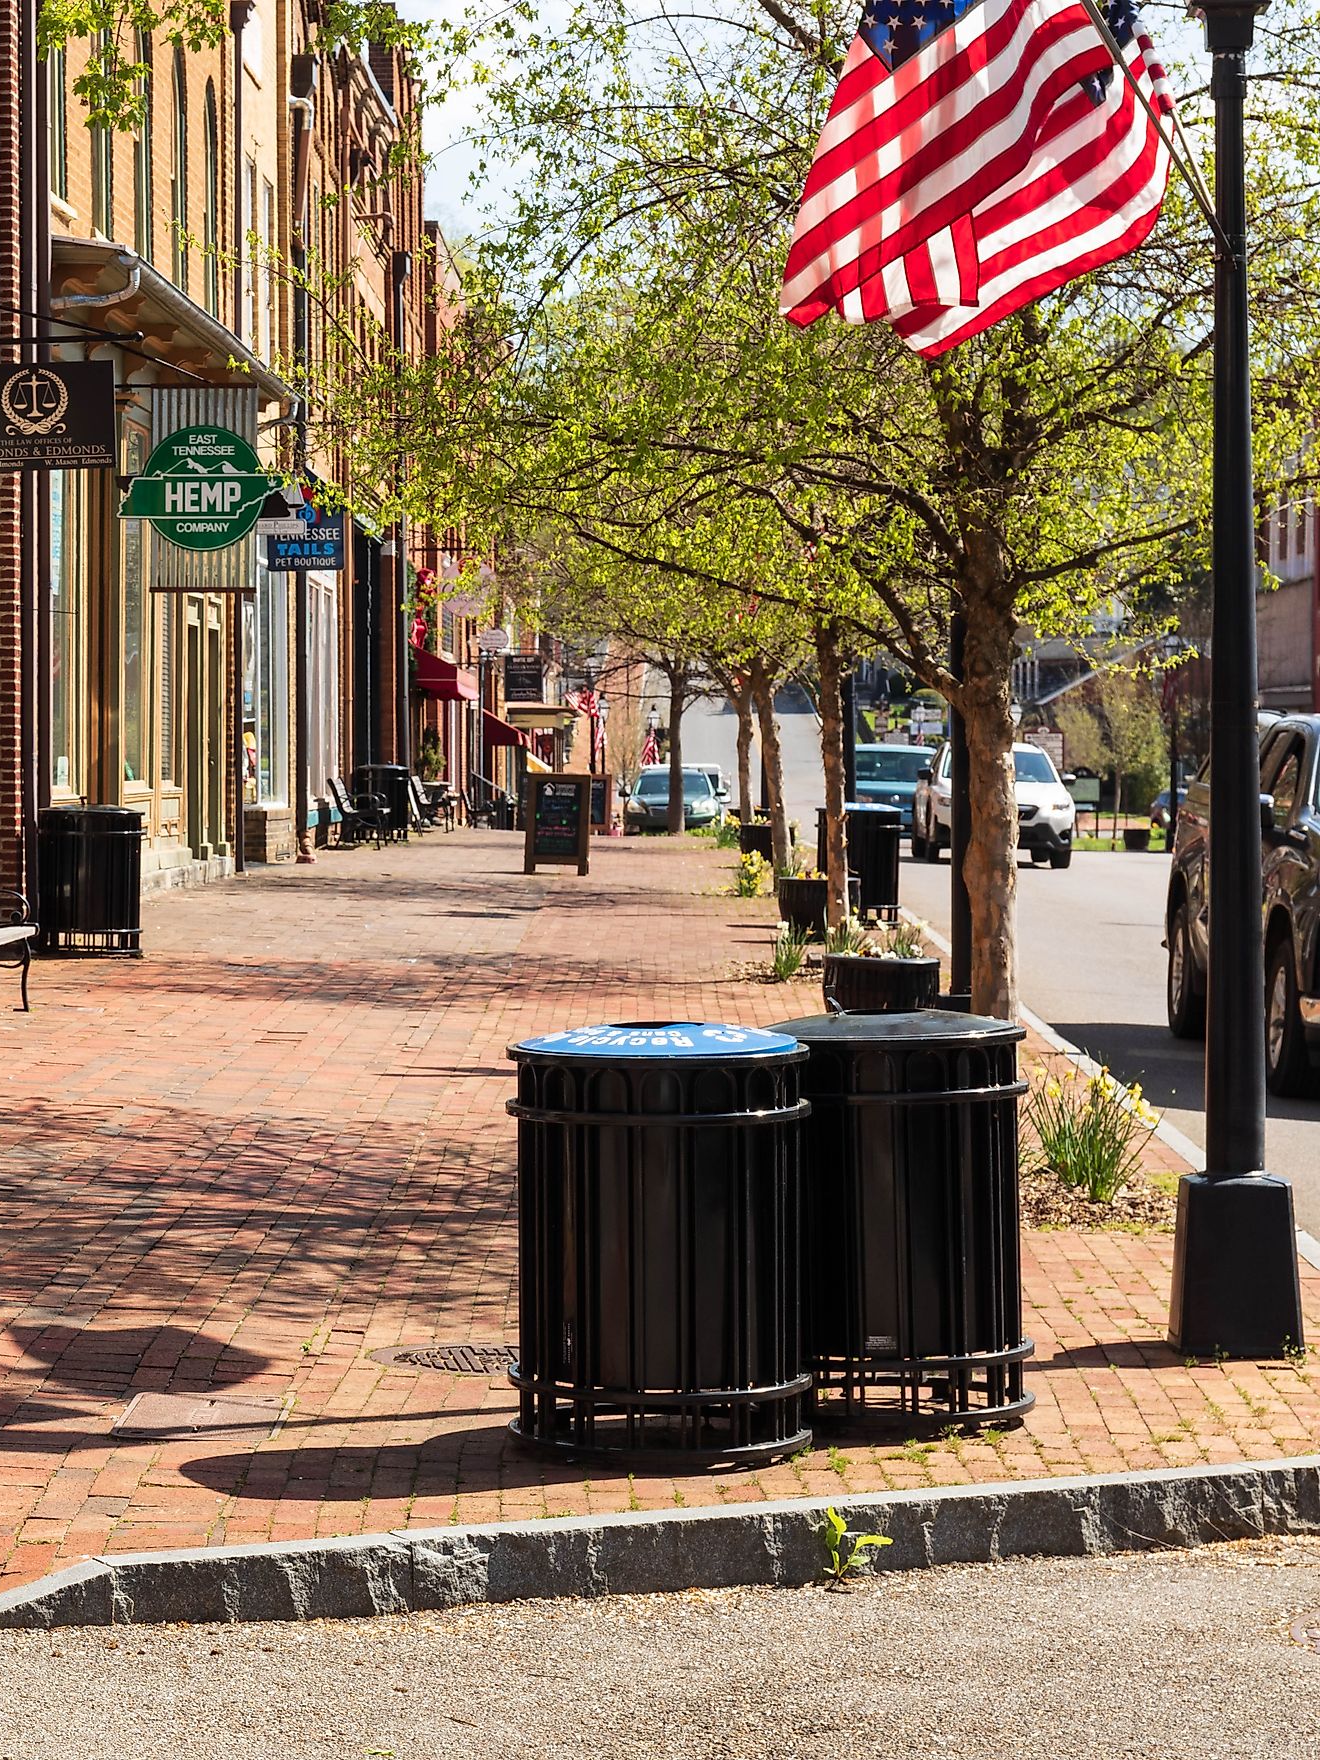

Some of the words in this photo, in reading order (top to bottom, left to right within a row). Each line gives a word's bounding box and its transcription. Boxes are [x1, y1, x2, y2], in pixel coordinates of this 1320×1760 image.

[0, 439, 14, 447] THE
[188, 434, 218, 445] EAST
[32, 446, 41, 457] &
[46, 445, 107, 456] EDMONDS
[171, 445, 236, 456] TENNESSEE
[55, 458, 79, 466] Mason
[81, 457, 113, 465] Edmonds
[164, 481, 242, 513] HEMP
[176, 522, 230, 533] COMPANY
[277, 543, 335, 556] TAILS
[275, 557, 292, 567] PET
[293, 557, 336, 567] BOUTIQUE
[567, 1034, 695, 1048] Recycle
